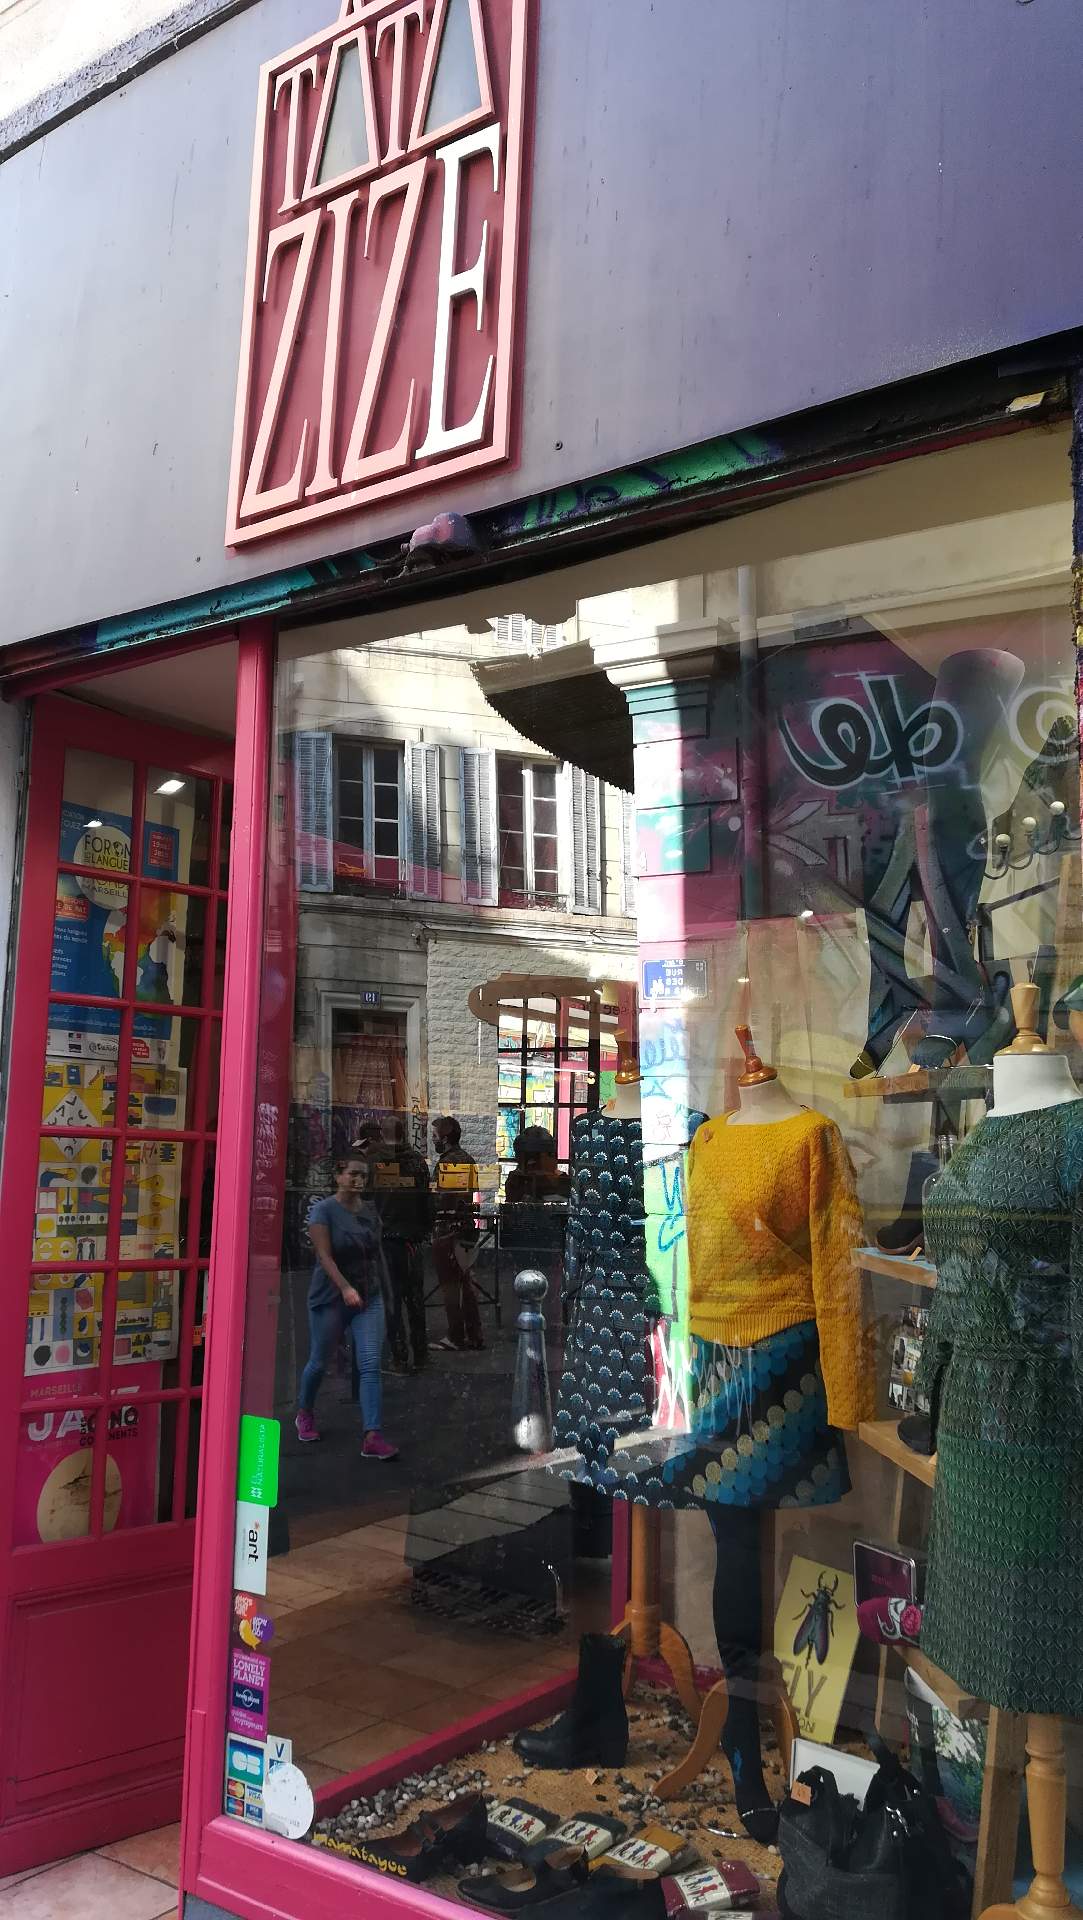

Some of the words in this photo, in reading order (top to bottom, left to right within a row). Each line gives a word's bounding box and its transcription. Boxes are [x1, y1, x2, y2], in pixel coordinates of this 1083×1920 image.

[274, 0, 496, 214] TATA
[240, 122, 501, 517] ZIZE
[91, 853, 129, 871] LANGUE
[82, 883, 128, 898] MARSEILL
[248, 1529, 260, 1563] art
[233, 1658, 265, 1676] LONELY
[233, 1669, 265, 1687] PLANET
[232, 1750, 261, 1776] CB
[248, 1788, 262, 1801] VISA
